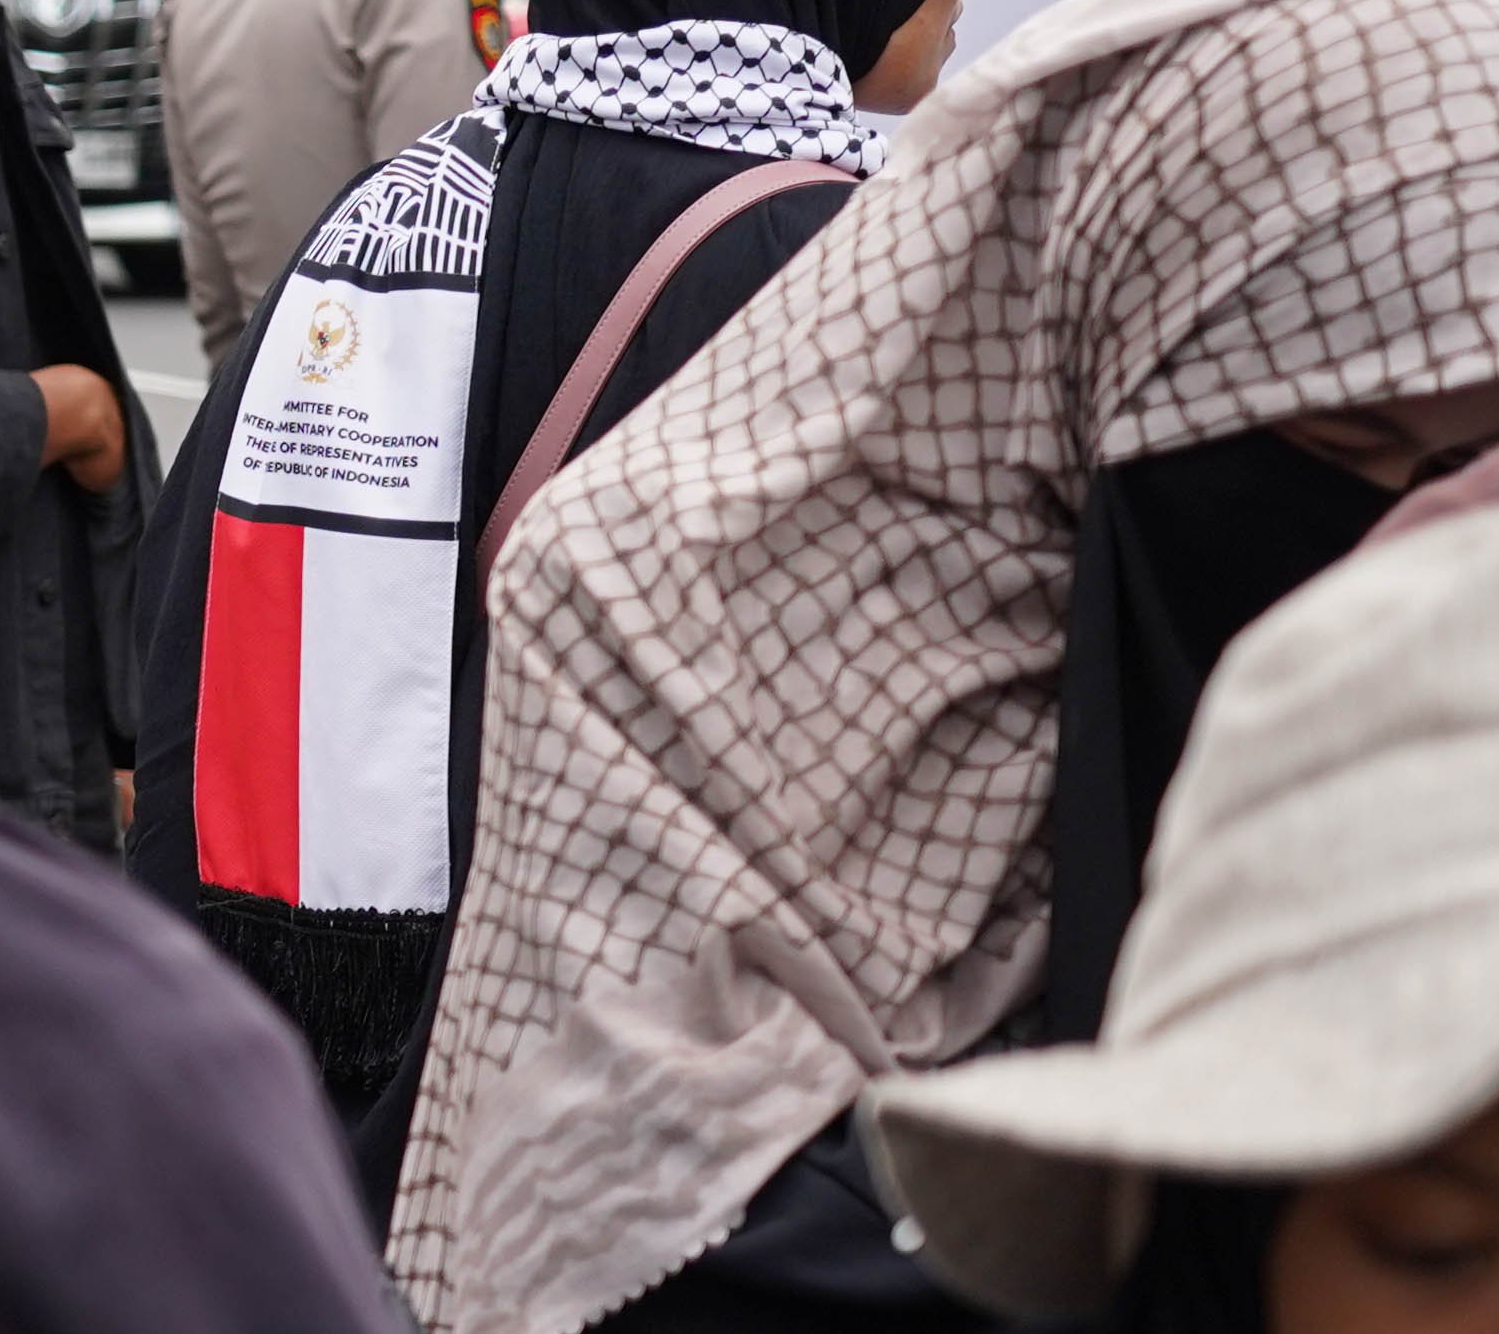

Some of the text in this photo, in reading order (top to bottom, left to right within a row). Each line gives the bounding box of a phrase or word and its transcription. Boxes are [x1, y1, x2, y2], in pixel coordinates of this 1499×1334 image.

[337, 406, 369, 423] FOR
[338, 428, 439, 448] COOPERATION
[279, 442, 297, 454] OF
[300, 443, 419, 468] REPRESENTATIVES
[243, 457, 410, 488] OF EPUBLIC OF INDONESIA
